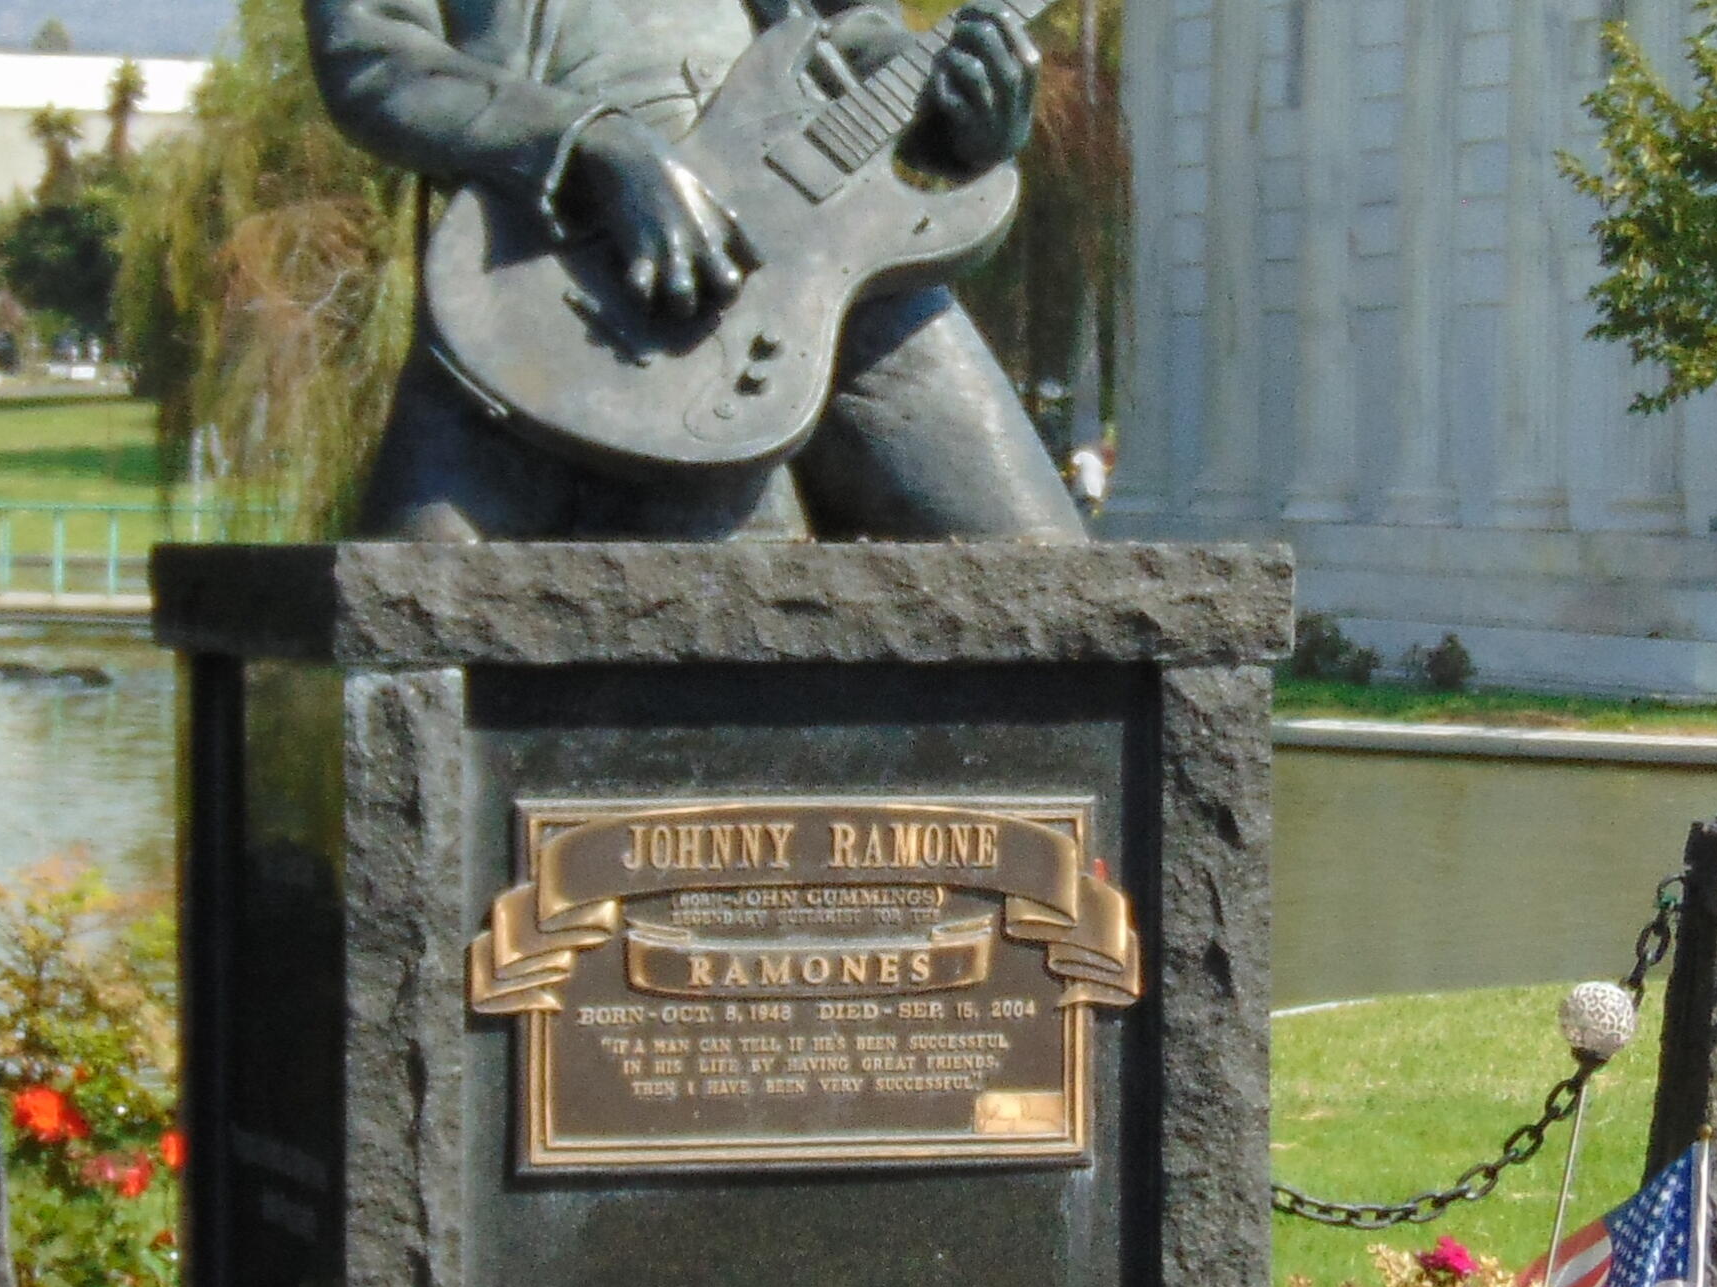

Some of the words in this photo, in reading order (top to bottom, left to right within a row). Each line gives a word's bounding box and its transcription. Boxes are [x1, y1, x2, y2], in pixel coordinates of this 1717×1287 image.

[622, 822, 794, 871] JOHNNY
[828, 822, 999, 870] RAMONE
[806, 886, 944, 907] CUMMINGS)
[688, 953, 931, 987] RAMONES
[749, 1004, 791, 1022] 1948
[991, 999, 1036, 1018] 2004
[634, 1038, 644, 1054] A
[653, 1039, 690, 1054] MAN
[699, 1038, 732, 1054] CAN
[788, 1036, 805, 1052] IF
[856, 1035, 897, 1051] BEEN
[909, 1033, 1009, 1050] SUCCESSFUL
[623, 1060, 641, 1074] IN
[655, 1060, 682, 1074] HIS
[699, 1058, 738, 1073] LIFE
[751, 1058, 775, 1073] BY
[787, 1057, 849, 1073] HAVING
[862, 1056, 916, 1071] GREAT
[632, 1081, 676, 1096] THEN
[687, 1081, 695, 1096] I
[707, 1079, 749, 1094] HAVE
[766, 1079, 806, 1094] BEEN
[819, 1078, 863, 1093] VERY
